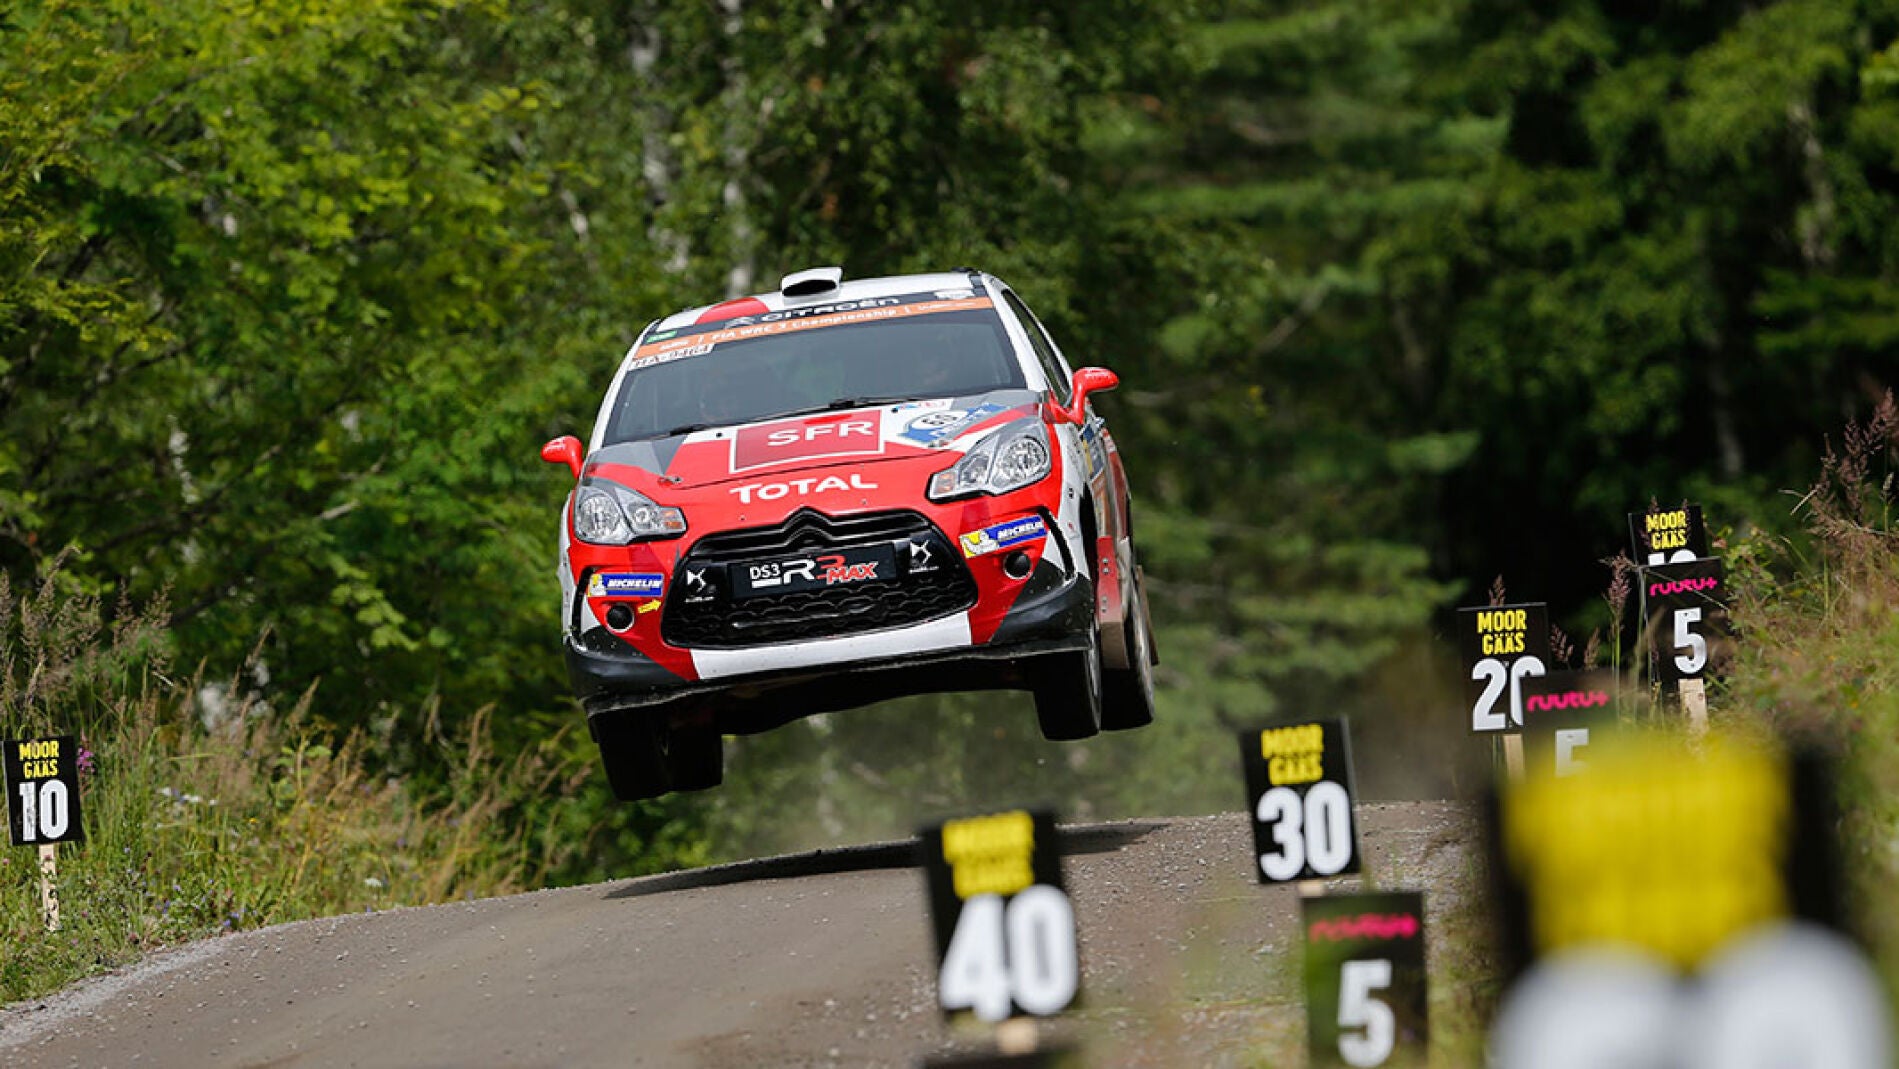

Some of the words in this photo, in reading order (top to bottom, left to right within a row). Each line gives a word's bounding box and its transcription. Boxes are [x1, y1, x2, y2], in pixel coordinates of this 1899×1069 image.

[740, 325, 773, 337] WRC
[792, 308, 897, 329] Championship
[767, 421, 874, 446] SFR
[729, 473, 879, 505] TOTAL
[1645, 510, 1688, 533] MOOR
[607, 577, 662, 589] MICHELIN
[750, 563, 782, 580] DS3
[826, 560, 879, 585] MAX
[1476, 609, 1528, 634] MOOR
[1481, 631, 1526, 656] GÄÄS
[1673, 606, 1707, 674] 5
[19, 740, 60, 761] MOOR
[18, 779, 69, 842] 10
[1256, 780, 1353, 882] 30
[938, 883, 1080, 1022] 40
[1337, 958, 1396, 1069] 5
